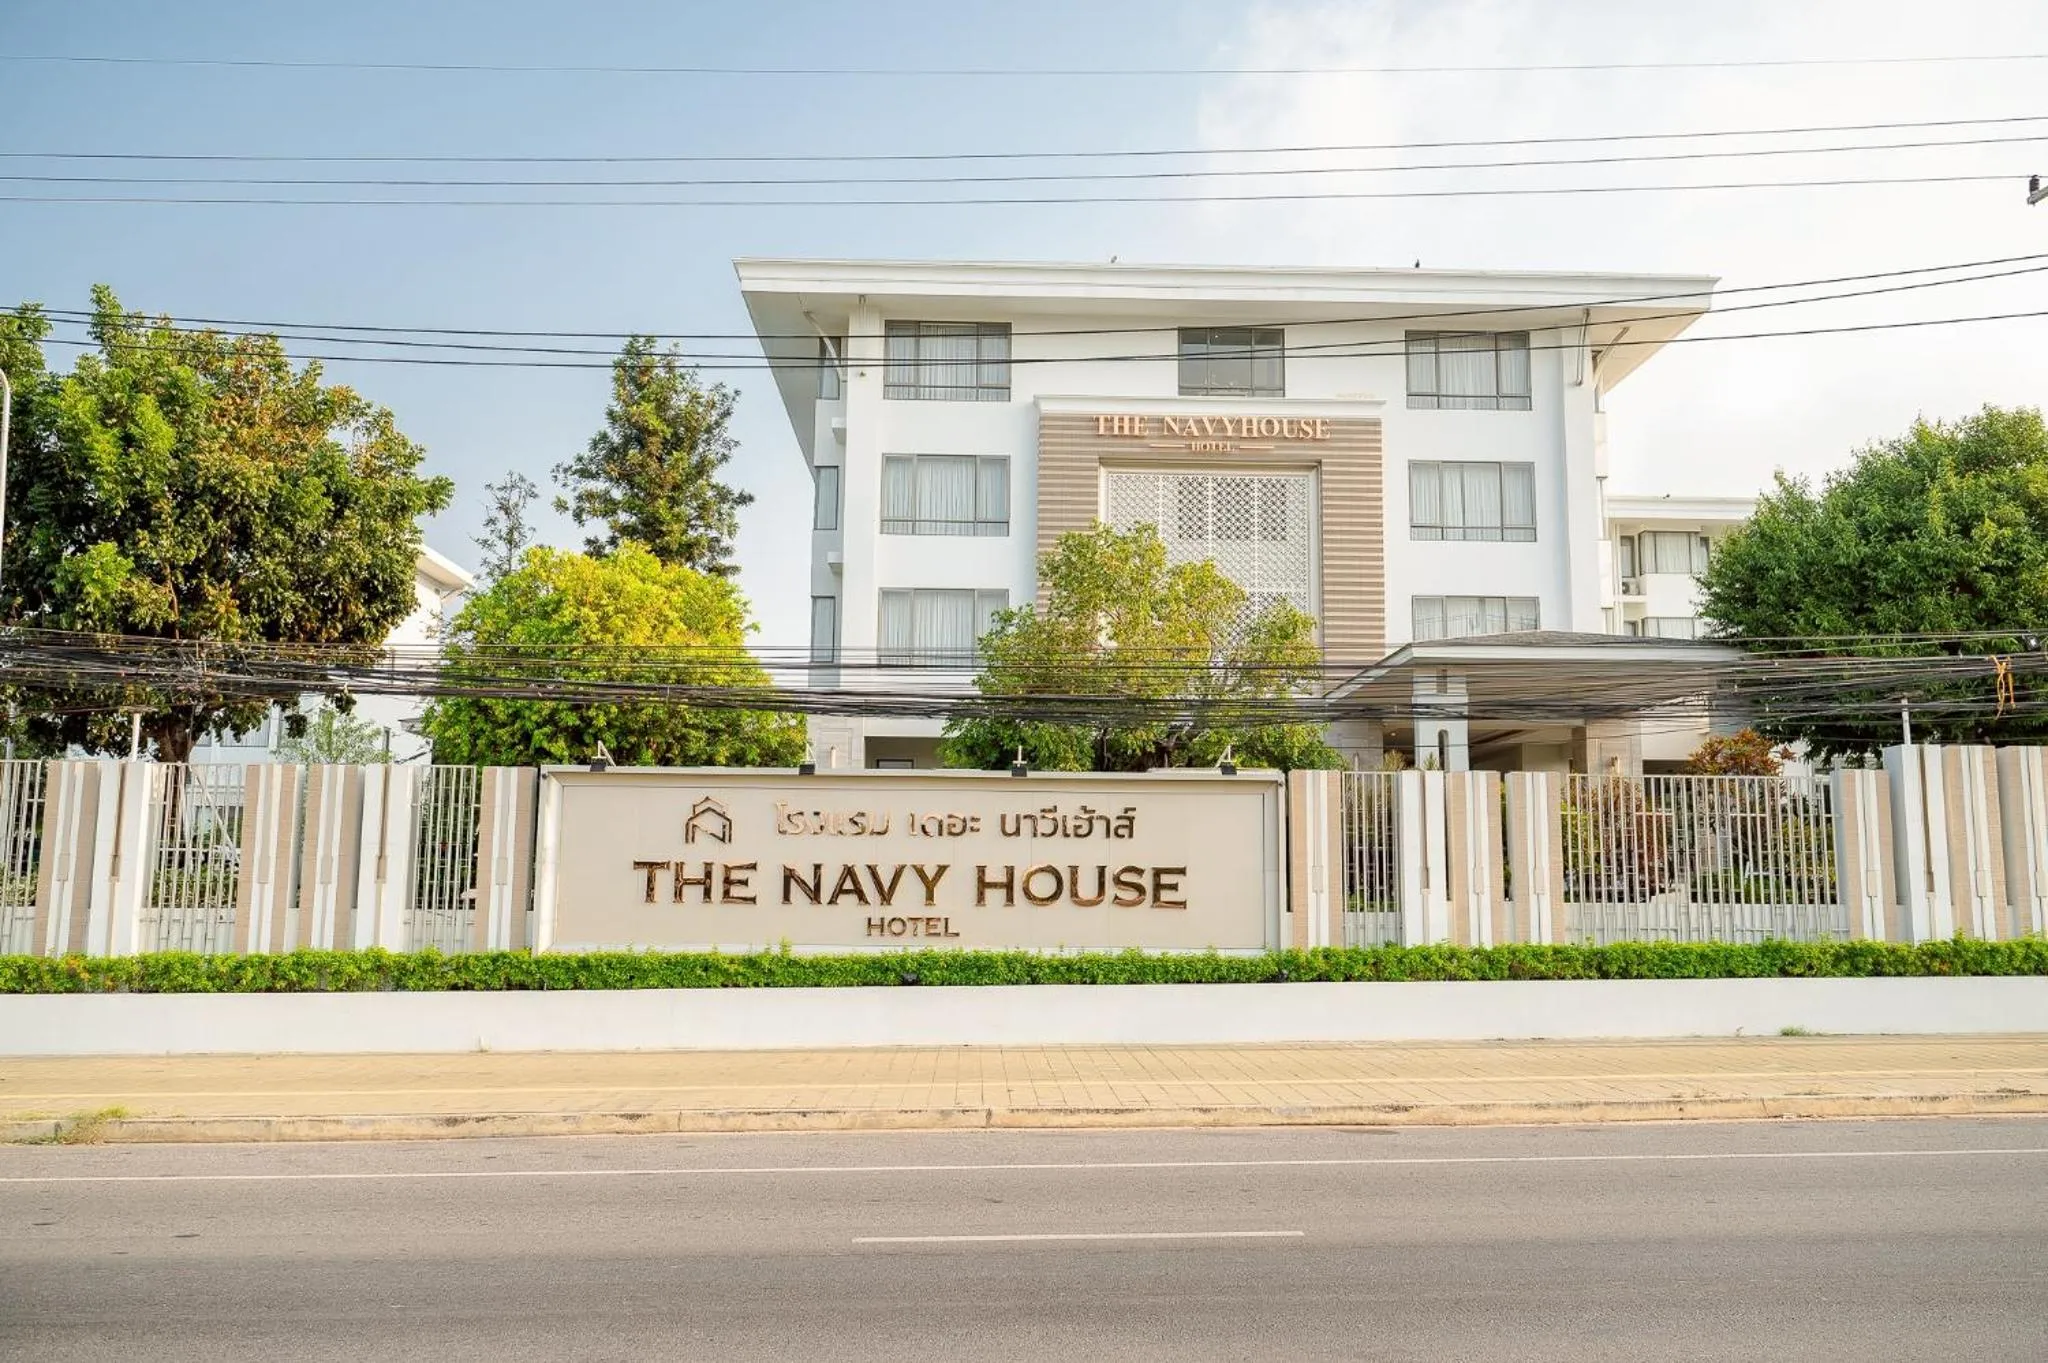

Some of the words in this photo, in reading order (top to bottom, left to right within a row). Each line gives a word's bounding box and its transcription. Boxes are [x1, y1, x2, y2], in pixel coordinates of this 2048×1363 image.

[1094, 415, 1149, 436] THE
[1163, 416, 1332, 439] NAVYHOUSE
[1190, 440, 1235, 452] HOTEL
[1000, 805, 1136, 838] นาวีเฮ้าส์
[633, 861, 757, 905] THE
[782, 863, 951, 906] NAVY
[975, 864, 1187, 909] HOUSE
[866, 917, 960, 937] HOTEL
